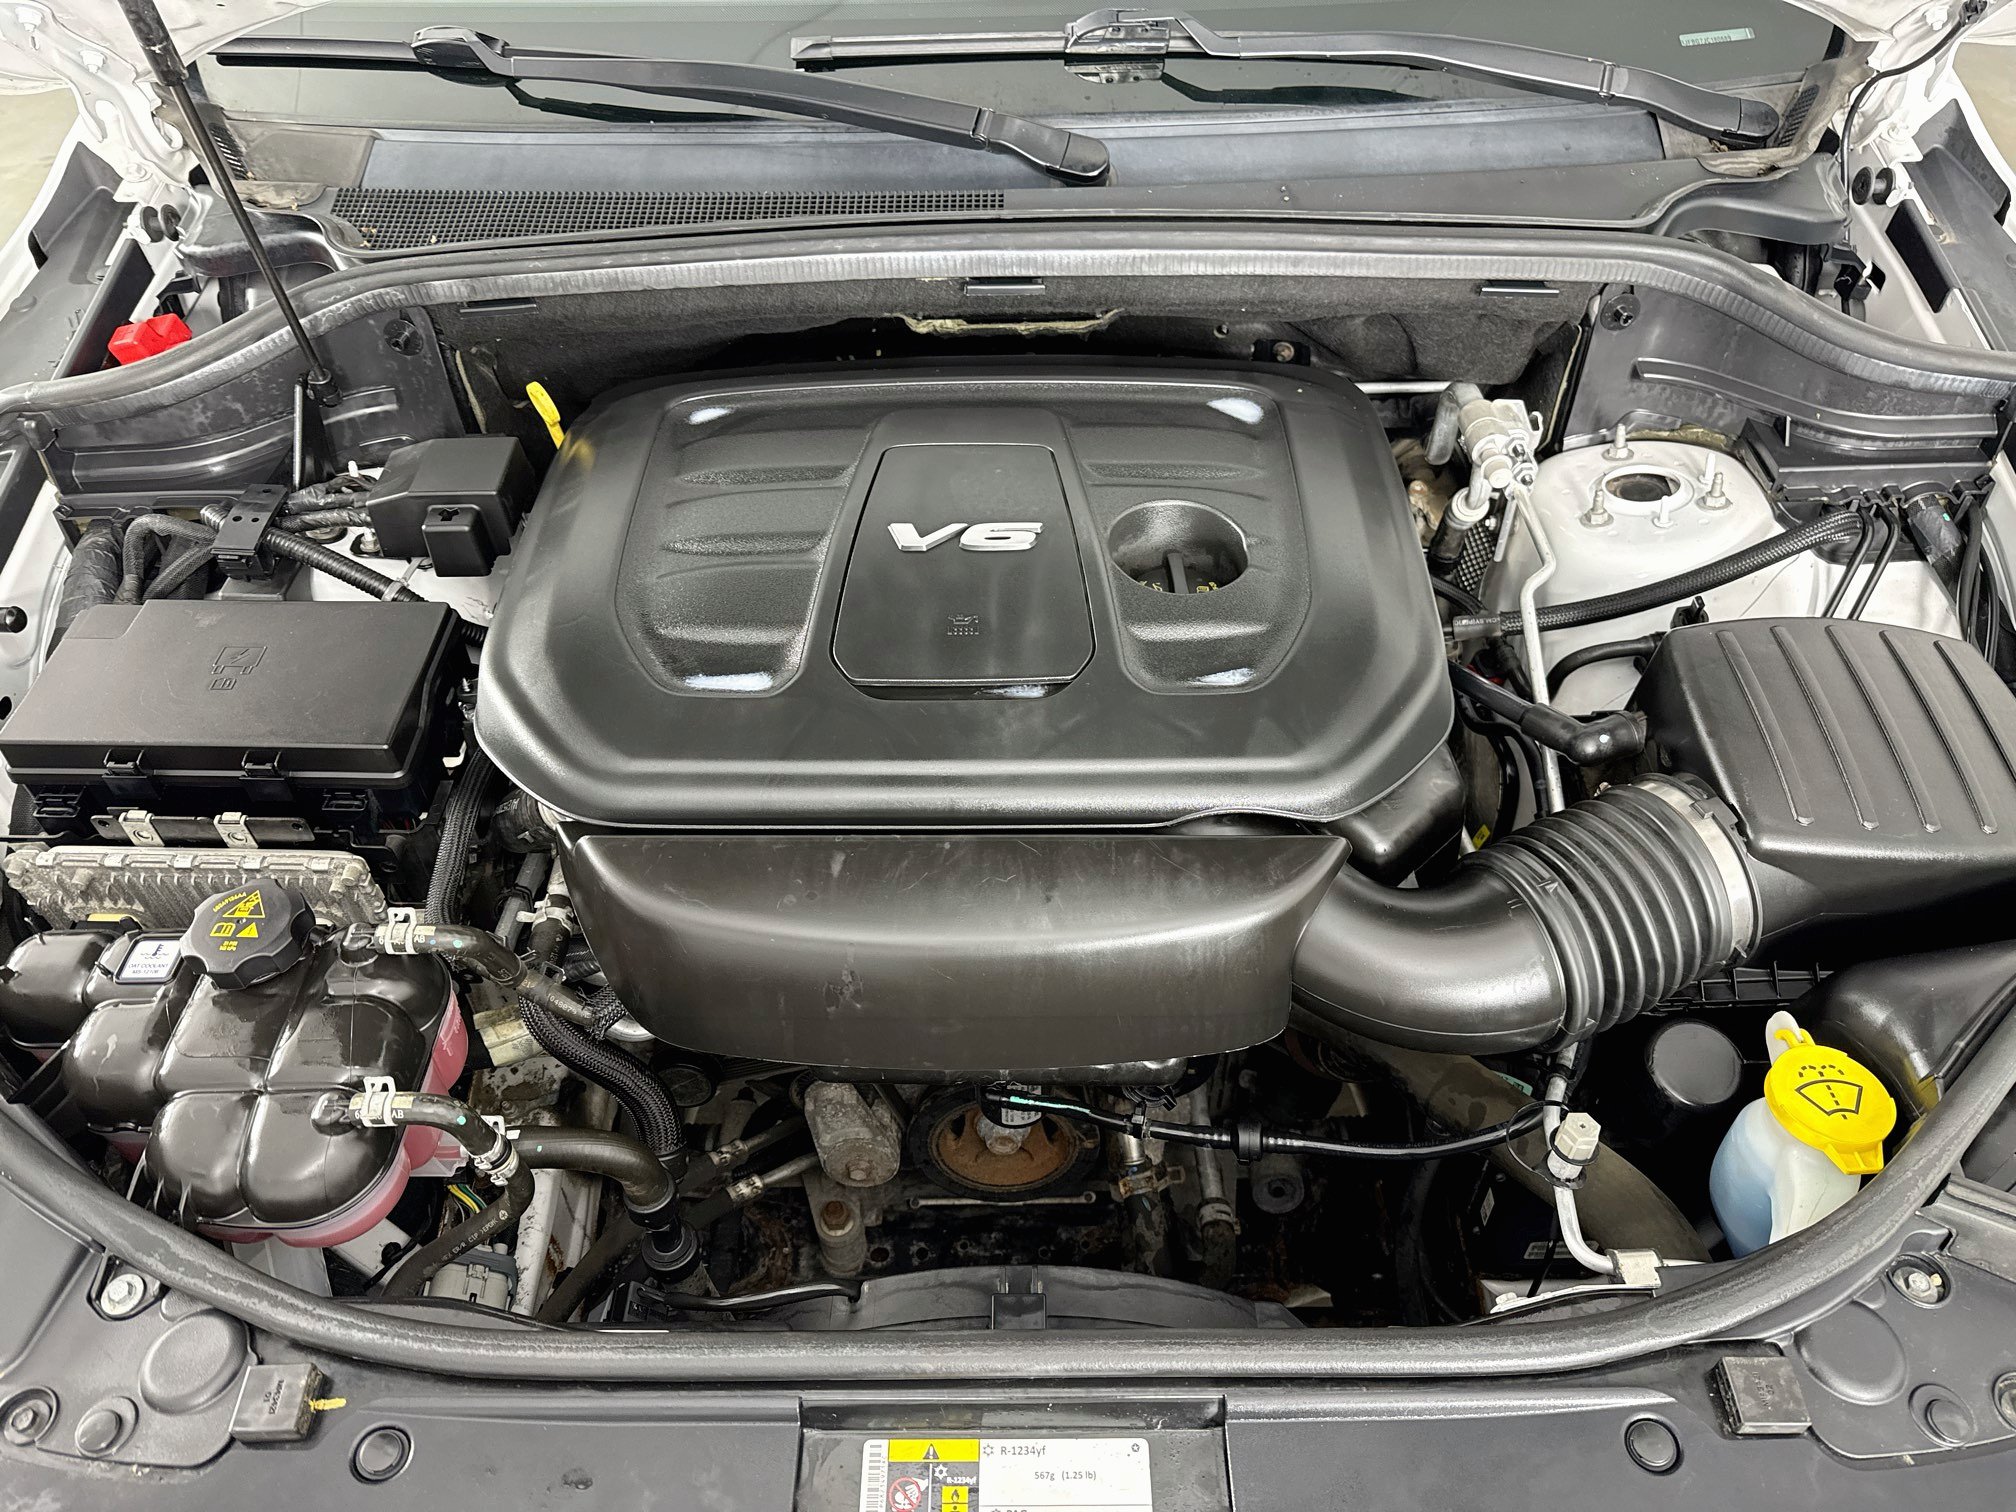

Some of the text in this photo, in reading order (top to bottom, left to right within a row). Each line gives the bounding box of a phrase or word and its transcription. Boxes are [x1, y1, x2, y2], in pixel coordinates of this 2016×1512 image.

[888, 522, 1043, 551] V6
[1000, 1445, 1046, 1457] R-1234yf
[1034, 1470, 1097, 1481] 567g (1.25 lb)
